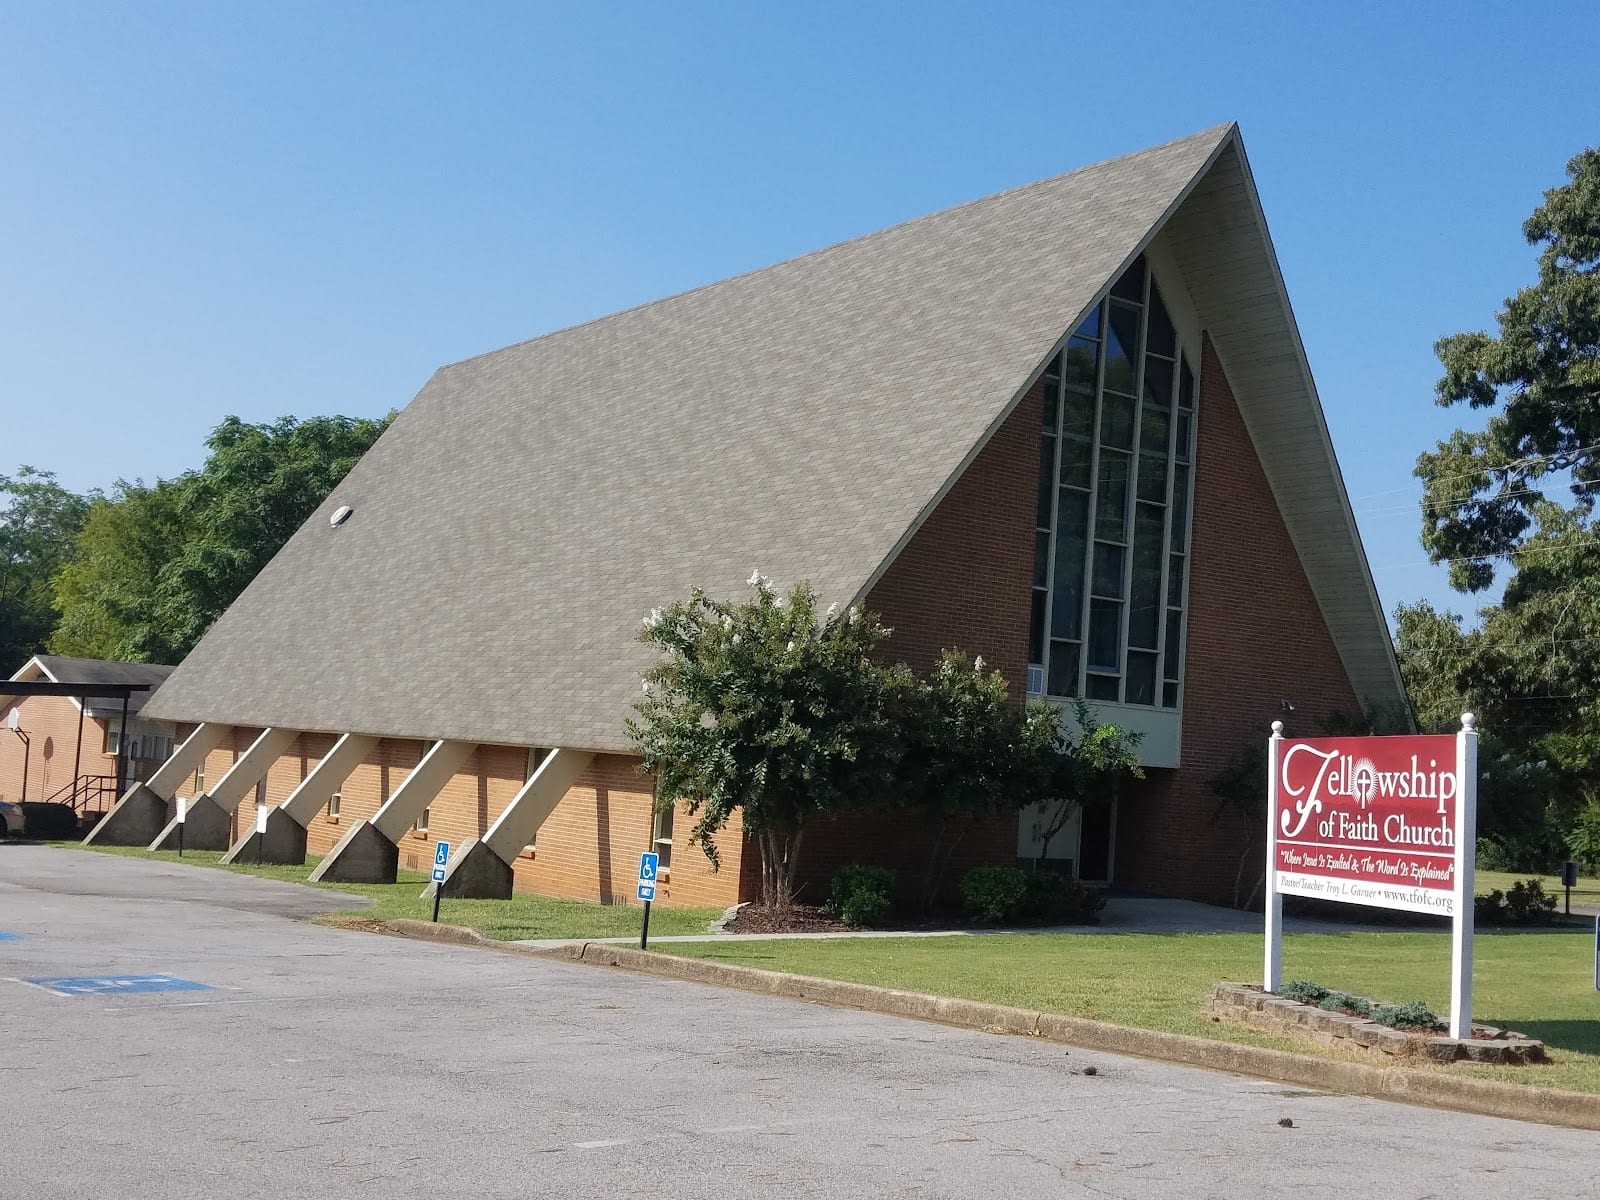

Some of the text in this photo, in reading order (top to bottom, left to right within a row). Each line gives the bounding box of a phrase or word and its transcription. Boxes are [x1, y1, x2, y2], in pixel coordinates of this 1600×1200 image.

[1281, 744, 1456, 837] Fellowship
[1319, 811, 1455, 847] of Faith Church
[1319, 854, 1326, 867] Is
[1351, 859, 1359, 874] &
[1361, 856, 1375, 873] The
[1376, 859, 1401, 875] Word
[1401, 862, 1409, 876] Is
[1326, 881, 1340, 897] Troy
[1342, 884, 1348, 894] L.
[1350, 884, 1377, 898] Garner
[1384, 889, 1454, 913] www.tfofc.org
